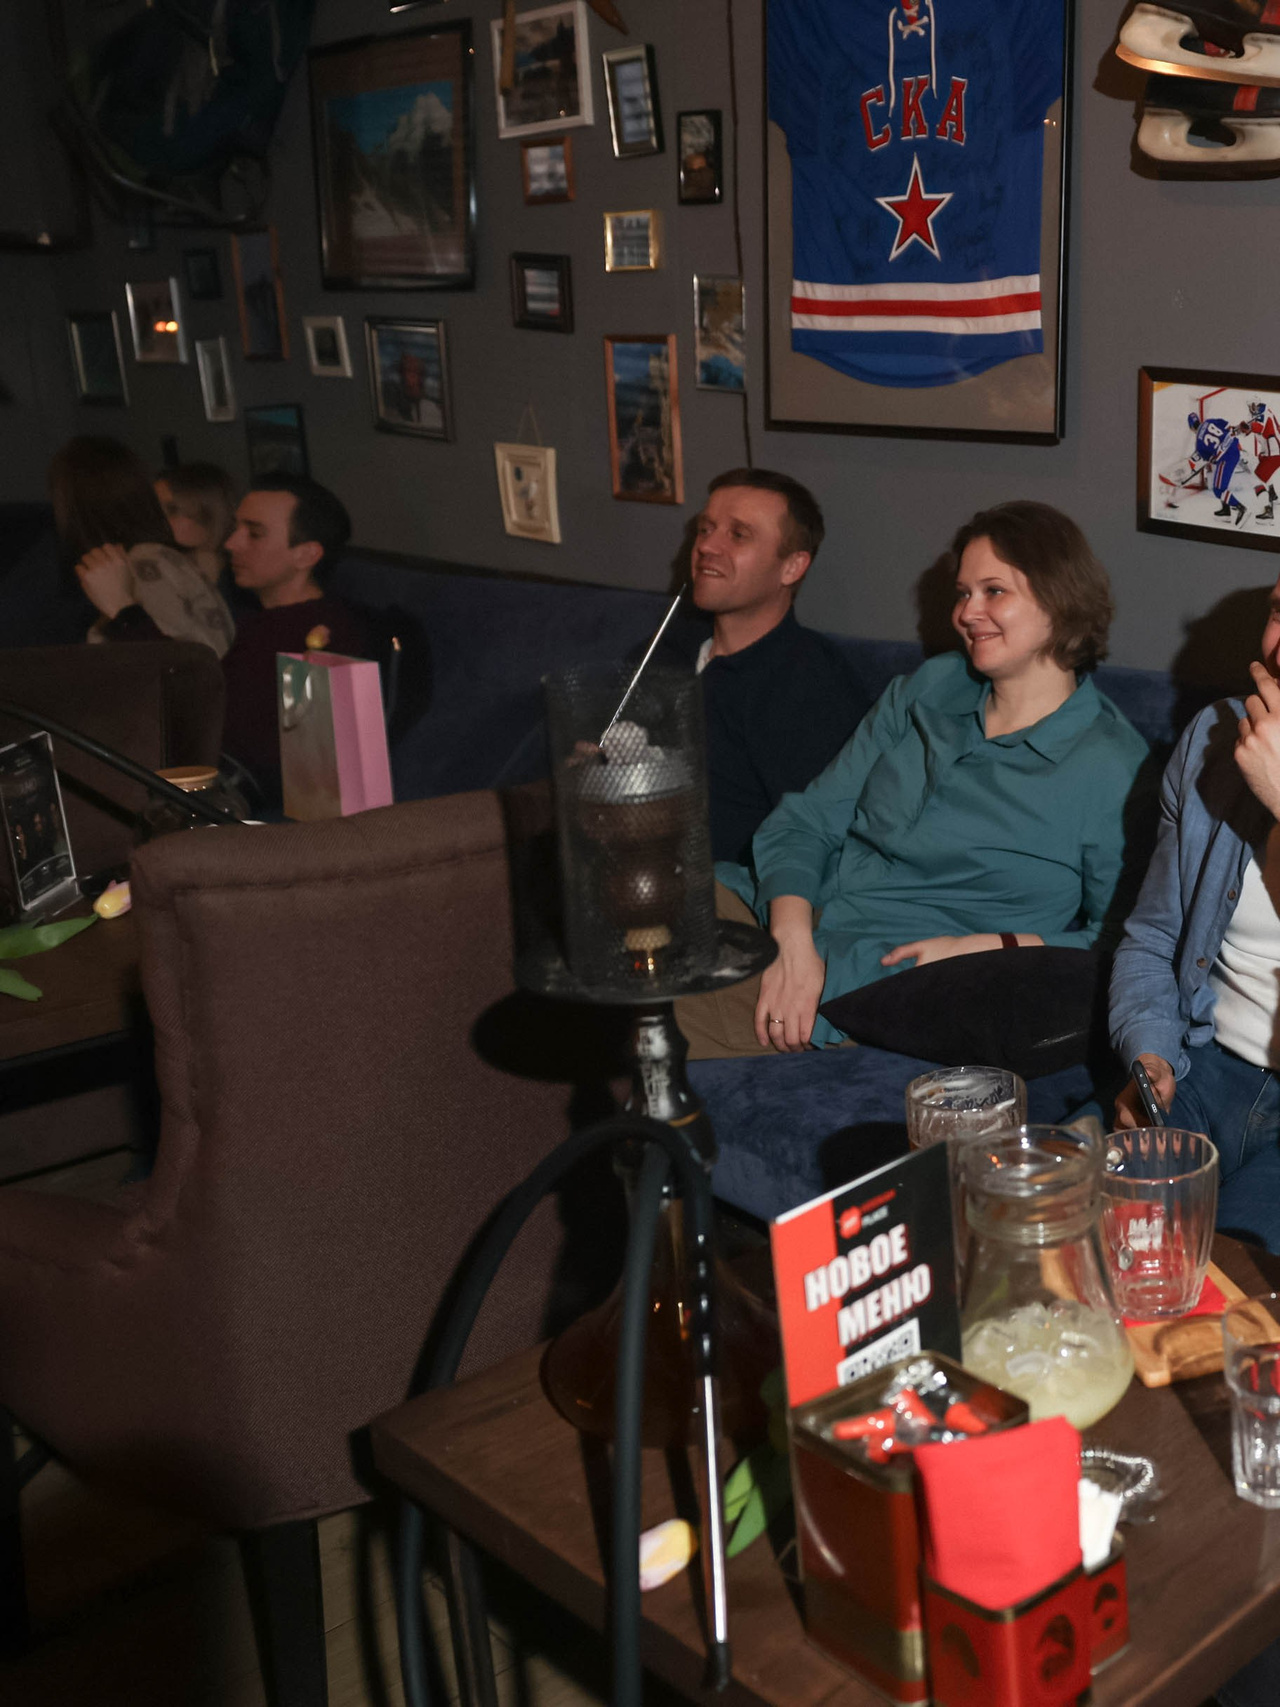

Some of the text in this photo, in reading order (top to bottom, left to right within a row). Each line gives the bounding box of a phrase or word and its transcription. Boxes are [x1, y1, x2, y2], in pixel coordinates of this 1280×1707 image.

[860, 74, 968, 151] СКА
[1203, 423, 1224, 450] 38
[804, 1223, 908, 1313] НОВОЕ
[836, 1263, 932, 1347] МЕНЮ
